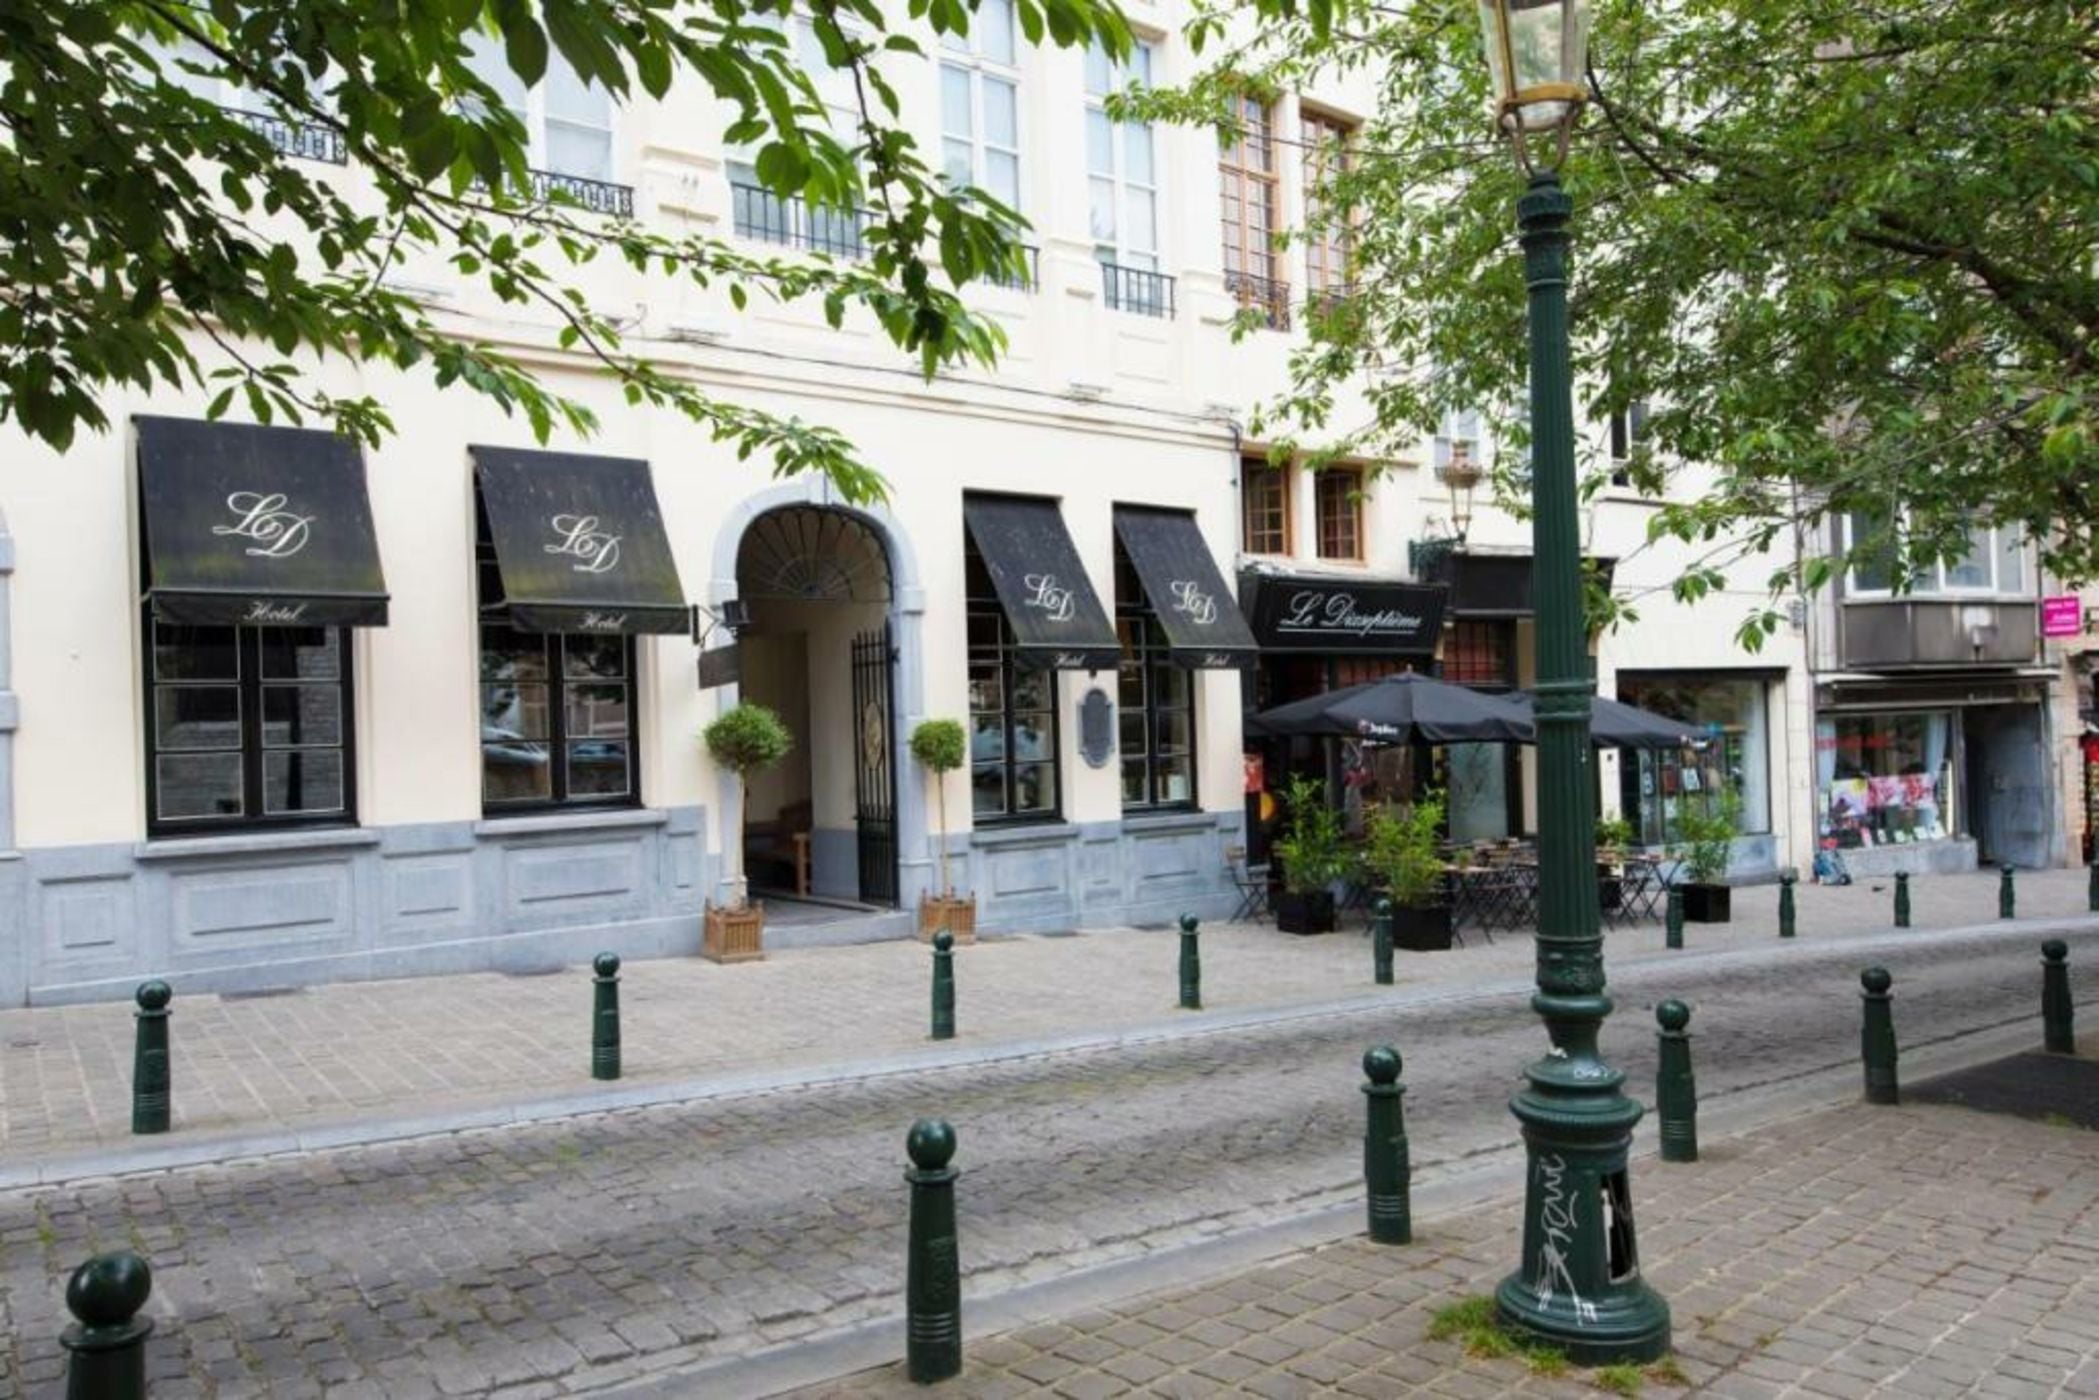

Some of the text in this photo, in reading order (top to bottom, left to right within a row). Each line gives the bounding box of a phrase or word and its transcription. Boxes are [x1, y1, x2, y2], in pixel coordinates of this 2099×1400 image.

[243, 600, 307, 621] Hotel
[1279, 591, 1324, 626] Le
[580, 611, 627, 629] Hotel
